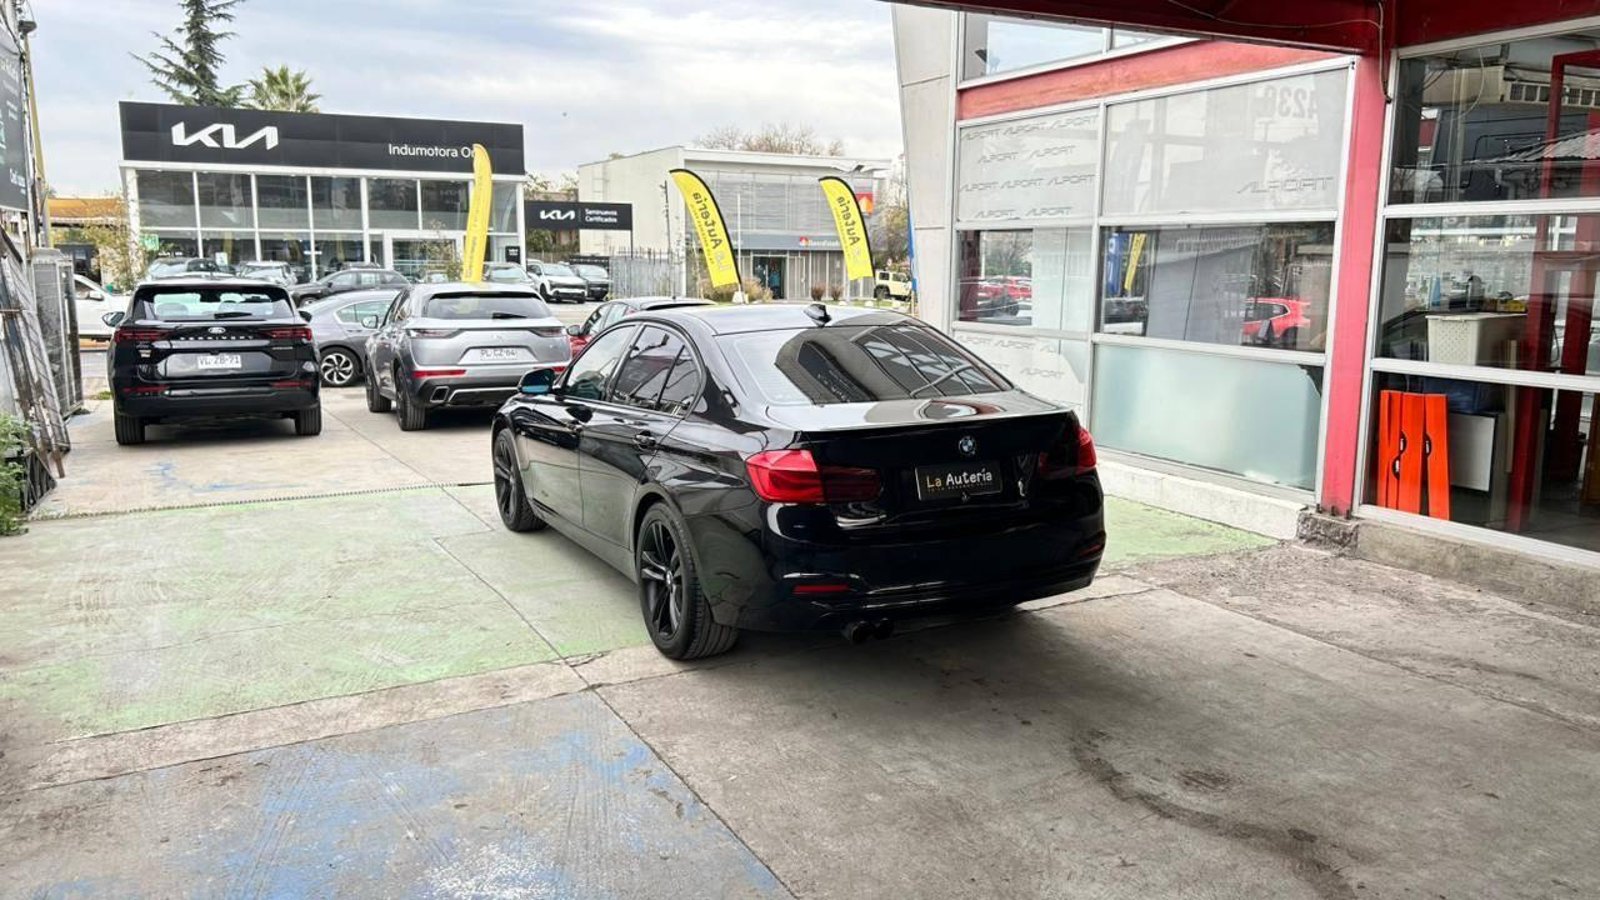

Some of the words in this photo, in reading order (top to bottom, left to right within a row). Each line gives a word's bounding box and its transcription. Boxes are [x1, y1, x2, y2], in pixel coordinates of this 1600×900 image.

[171, 121, 279, 150] KIA
[388, 143, 458, 157] Indumotora
[540, 209, 576, 221] KIA
[926, 475, 942, 488] La
[945, 467, 993, 487] Autería
